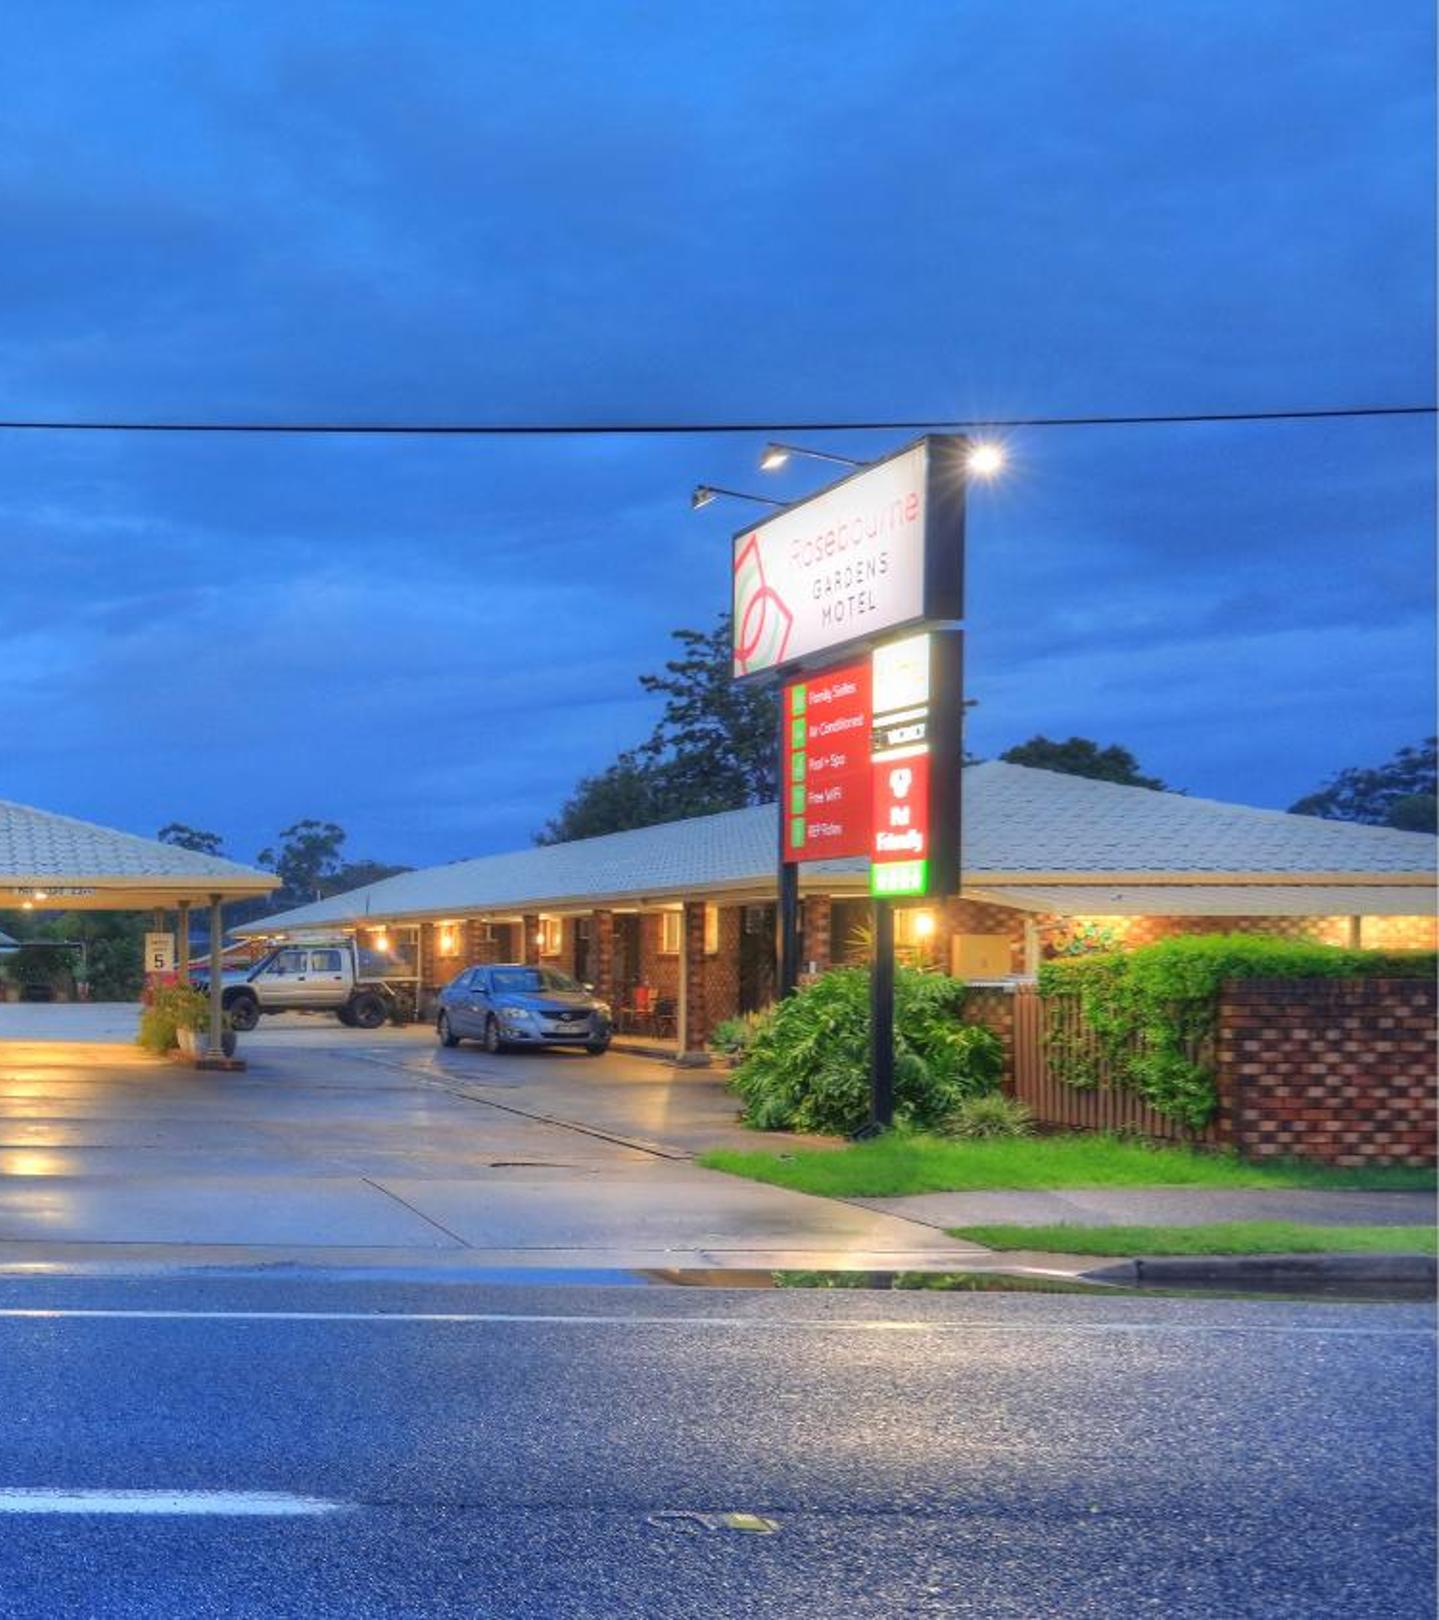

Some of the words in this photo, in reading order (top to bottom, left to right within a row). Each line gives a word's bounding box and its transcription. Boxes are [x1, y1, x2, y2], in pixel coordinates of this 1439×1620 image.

[813, 552, 888, 599] GARDENS
[821, 590, 877, 630] MOTEL
[154, 953, 165, 969] 5
